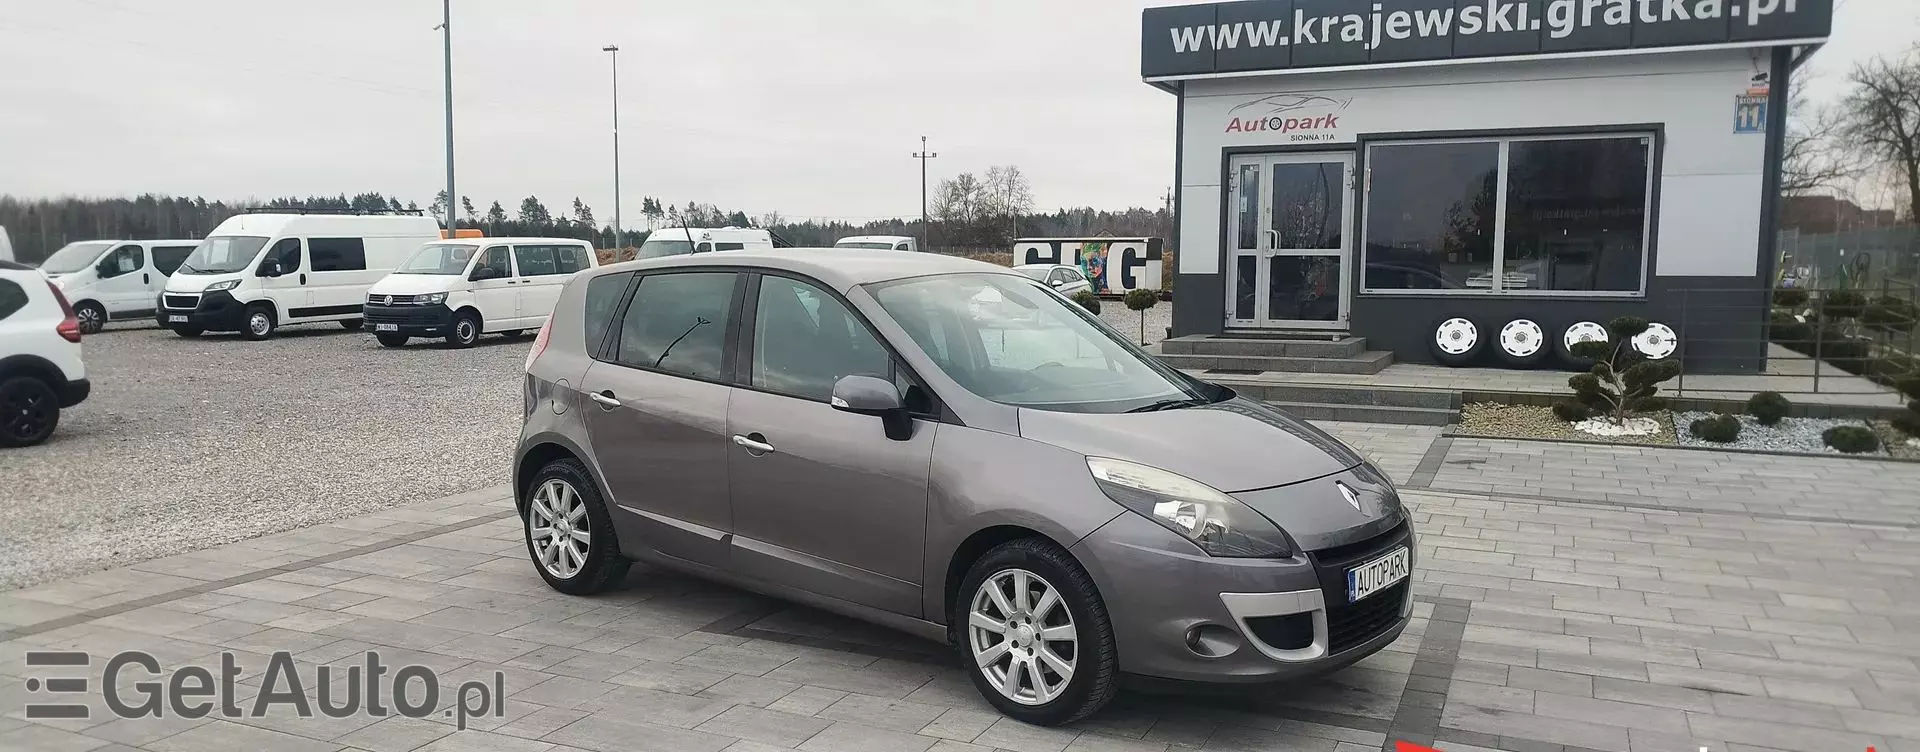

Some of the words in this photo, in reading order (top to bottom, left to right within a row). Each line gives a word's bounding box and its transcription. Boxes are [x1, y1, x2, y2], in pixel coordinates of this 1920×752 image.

[1290, 134, 1320, 142] SIONNA
[1322, 133, 1335, 141] 11A
[1357, 550, 1406, 597] AUTOPARK
